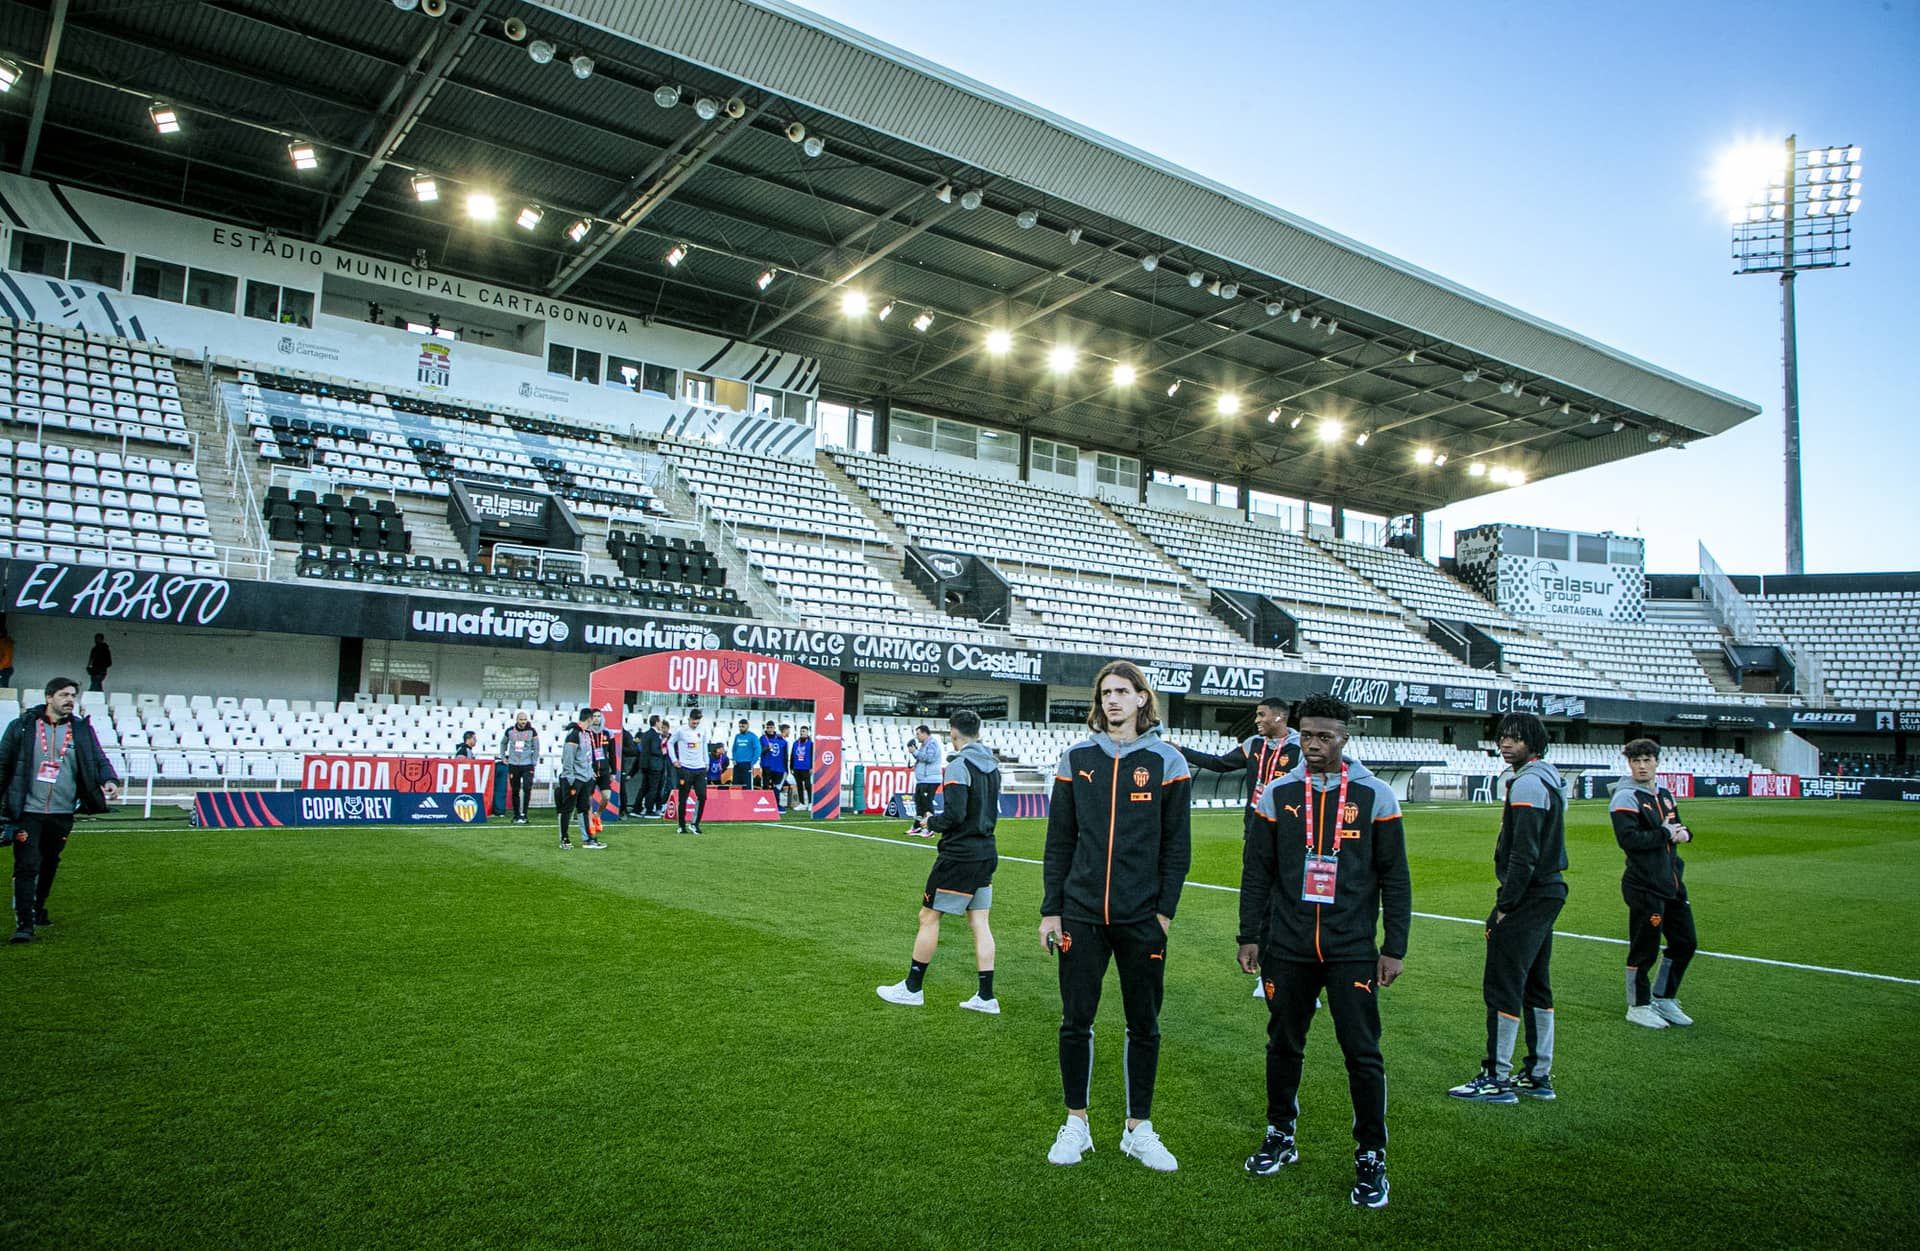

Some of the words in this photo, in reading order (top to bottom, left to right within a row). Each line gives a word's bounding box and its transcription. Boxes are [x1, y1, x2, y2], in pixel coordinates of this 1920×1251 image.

[213, 228, 323, 265] ESTADIO
[336, 256, 467, 299] MUNICIPAL
[479, 289, 628, 334] CARTAGONOVA
[468, 493, 544, 513] Talasur
[16, 563, 68, 610] EL
[70, 568, 230, 625] ABASTO
[1540, 576, 1614, 595] Talasur
[1544, 591, 1581, 604] group
[503, 610, 560, 623] mobility
[1551, 603, 1604, 617] CARTAGENA
[663, 623, 712, 634] mobility
[732, 625, 846, 655] CARTAGO
[853, 635, 942, 662] CARTAGO
[854, 657, 900, 670] telecom
[967, 647, 1042, 674] Castellini
[668, 656, 720, 693] COPA
[745, 661, 780, 695] REY
[1201, 666, 1264, 690] AMG
[1344, 677, 1390, 705] ABASTO
[306, 760, 390, 790] COPA
[436, 763, 491, 793] REY
[1776, 776, 1792, 796] REY
[1801, 779, 1865, 791] Talasur
[1803, 789, 1834, 797] group
[302, 797, 345, 819] COPA
[364, 797, 392, 819] REY
